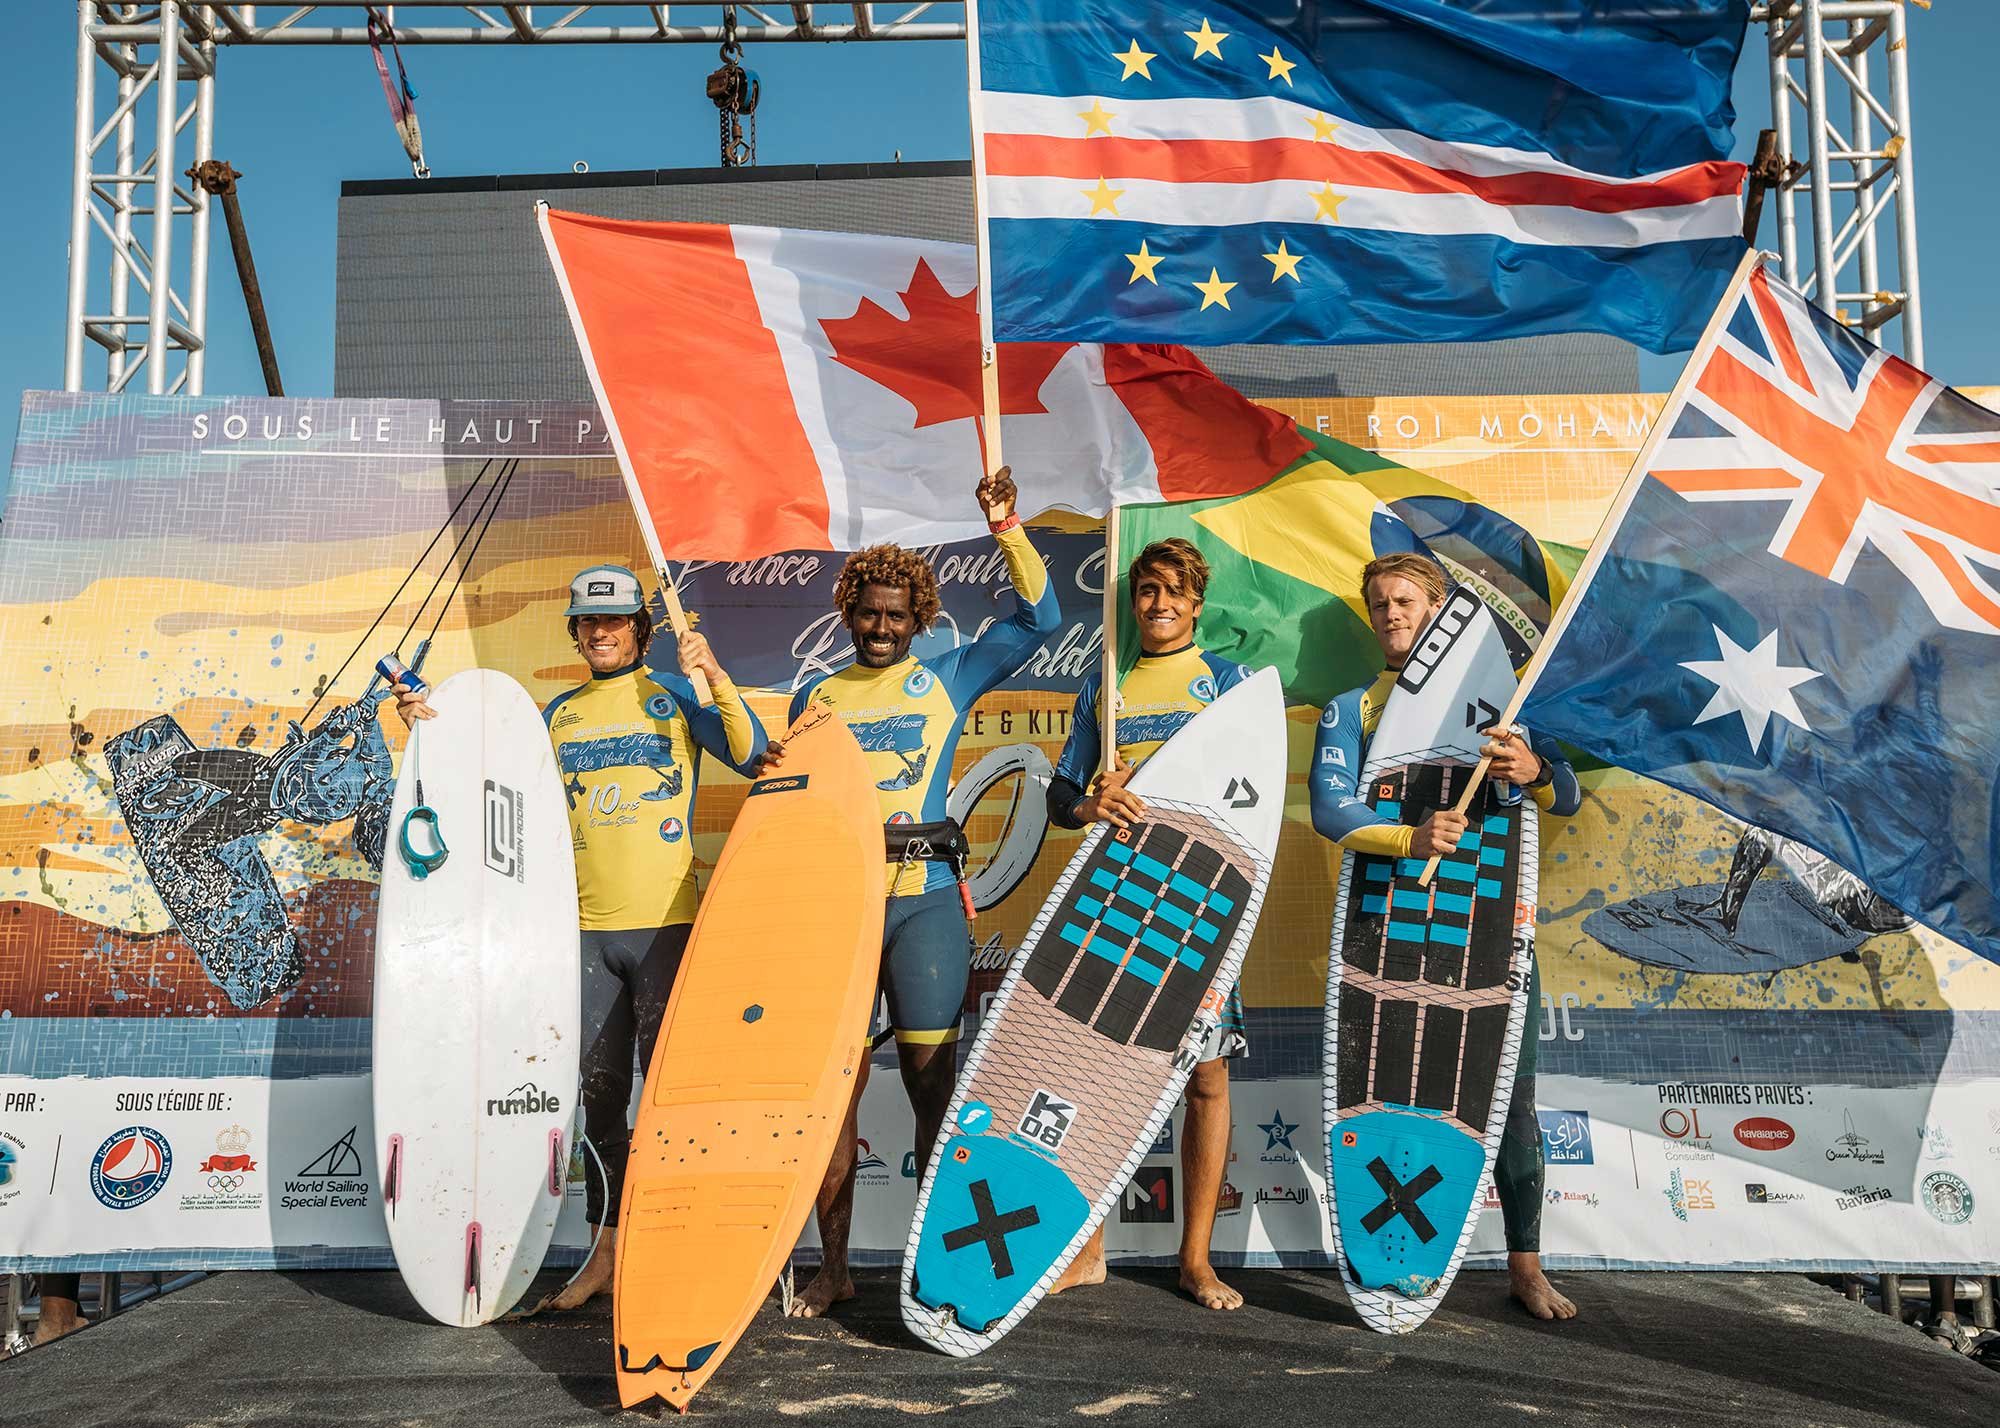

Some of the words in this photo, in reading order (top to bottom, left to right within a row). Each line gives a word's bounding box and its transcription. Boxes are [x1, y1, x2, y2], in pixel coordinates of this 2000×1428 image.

[192, 414, 313, 441] SOUS
[350, 415, 391, 442] LE
[427, 418, 542, 444] HAUT
[1367, 414, 1442, 440] ROI
[1479, 412, 1651, 440] MOHAM
[1001, 710, 1013, 735] &
[1028, 709, 1069, 735] KIT
[587, 783, 622, 817] 10
[516, 790, 524, 837] RODEO
[516, 837, 525, 885] OCEAN
[5, 1092, 36, 1112] PAR
[116, 1093, 154, 1111] SOUS
[207, 1092, 225, 1111] DE
[487, 1090, 560, 1116] rumble
[1657, 1084, 1751, 1105] PARTENAIRES
[1755, 1082, 1805, 1105] PRIVÉS
[1020, 1116, 1063, 1148] 08
[1274, 1127, 1283, 1138] 3
[1660, 1107, 1713, 1139] OL
[1738, 1127, 1790, 1140] havaianas
[3, 1131, 27, 1150] Dakhla
[1663, 1140, 1713, 1151] DAKHLA
[1664, 1151, 1715, 1161] Consultant
[284, 1180, 325, 1193] World
[326, 1180, 369, 1195] Sailing
[1684, 1179, 1713, 1194] PK
[1922, 1172, 1970, 1196] STARBUCKS
[280, 1195, 328, 1210] Special
[330, 1196, 368, 1208] Event
[1687, 1195, 1716, 1209] 25
[1766, 1192, 1806, 1201] SAHAM
[1835, 1187, 1893, 1211] Bavaria
